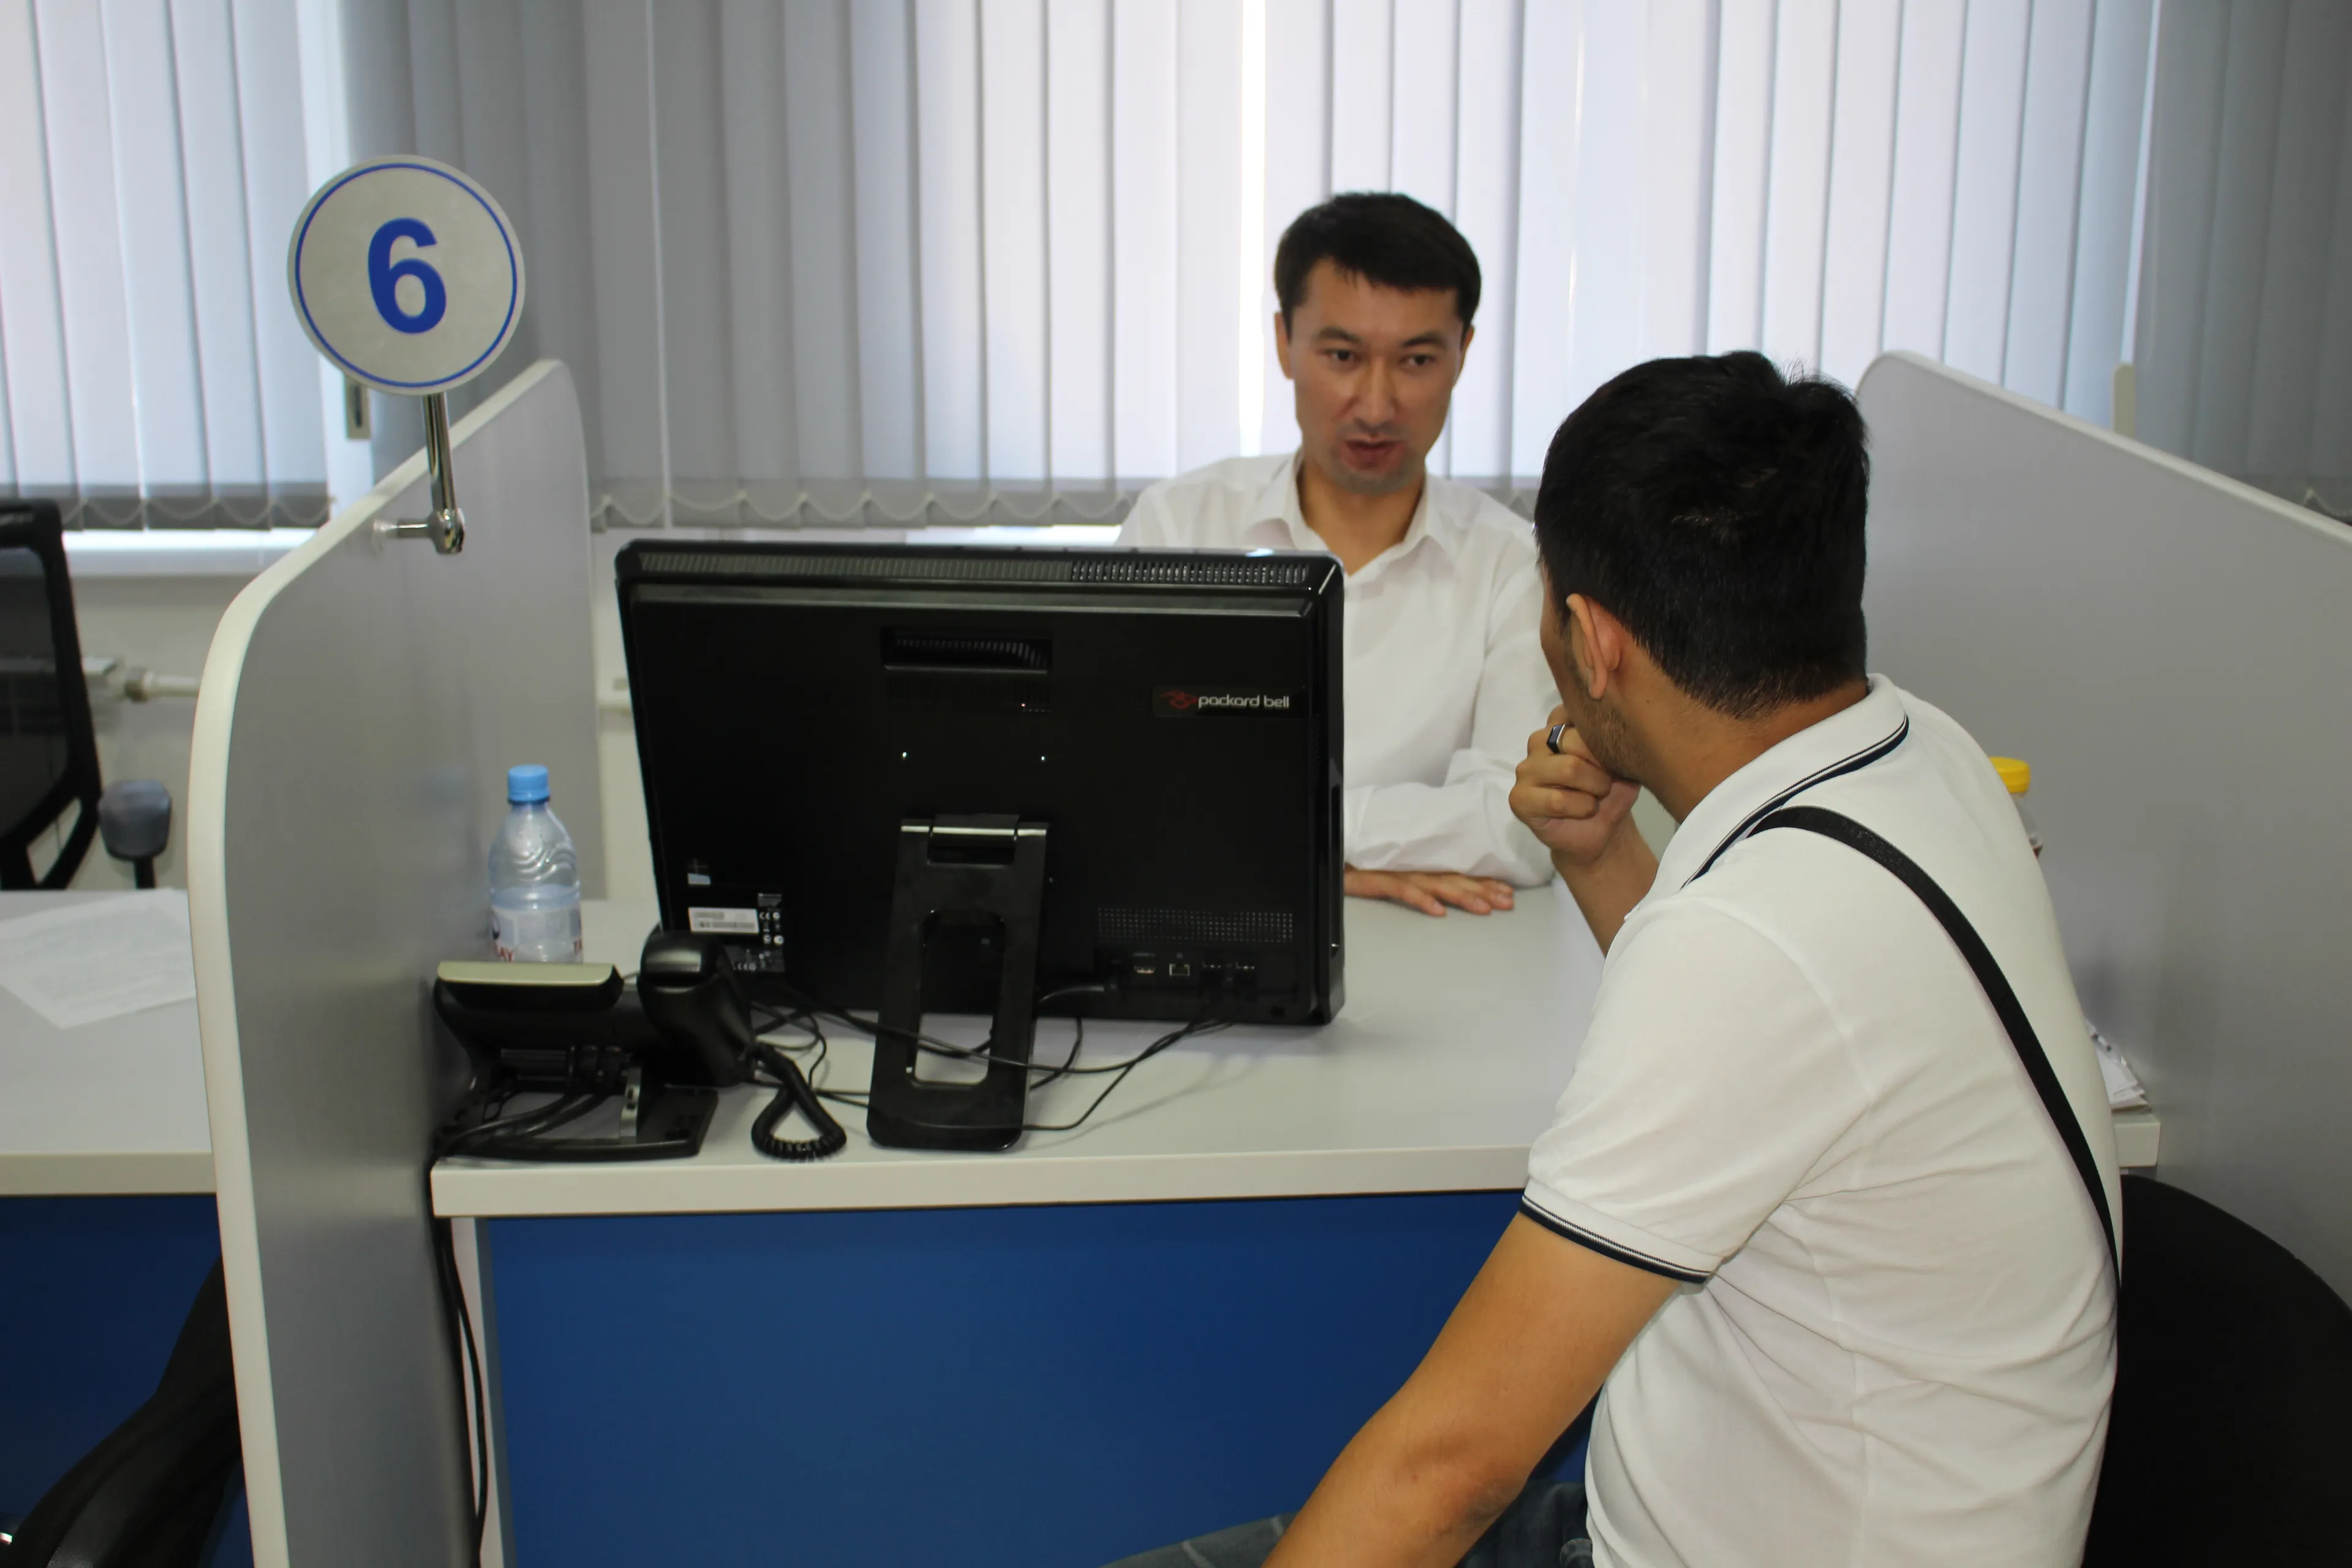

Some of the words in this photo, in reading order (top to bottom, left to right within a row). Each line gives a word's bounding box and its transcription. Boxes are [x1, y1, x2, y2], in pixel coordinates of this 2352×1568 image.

[368, 217, 447, 334] 6
[1198, 694, 1260, 709] packard
[1264, 695, 1289, 708] bell
